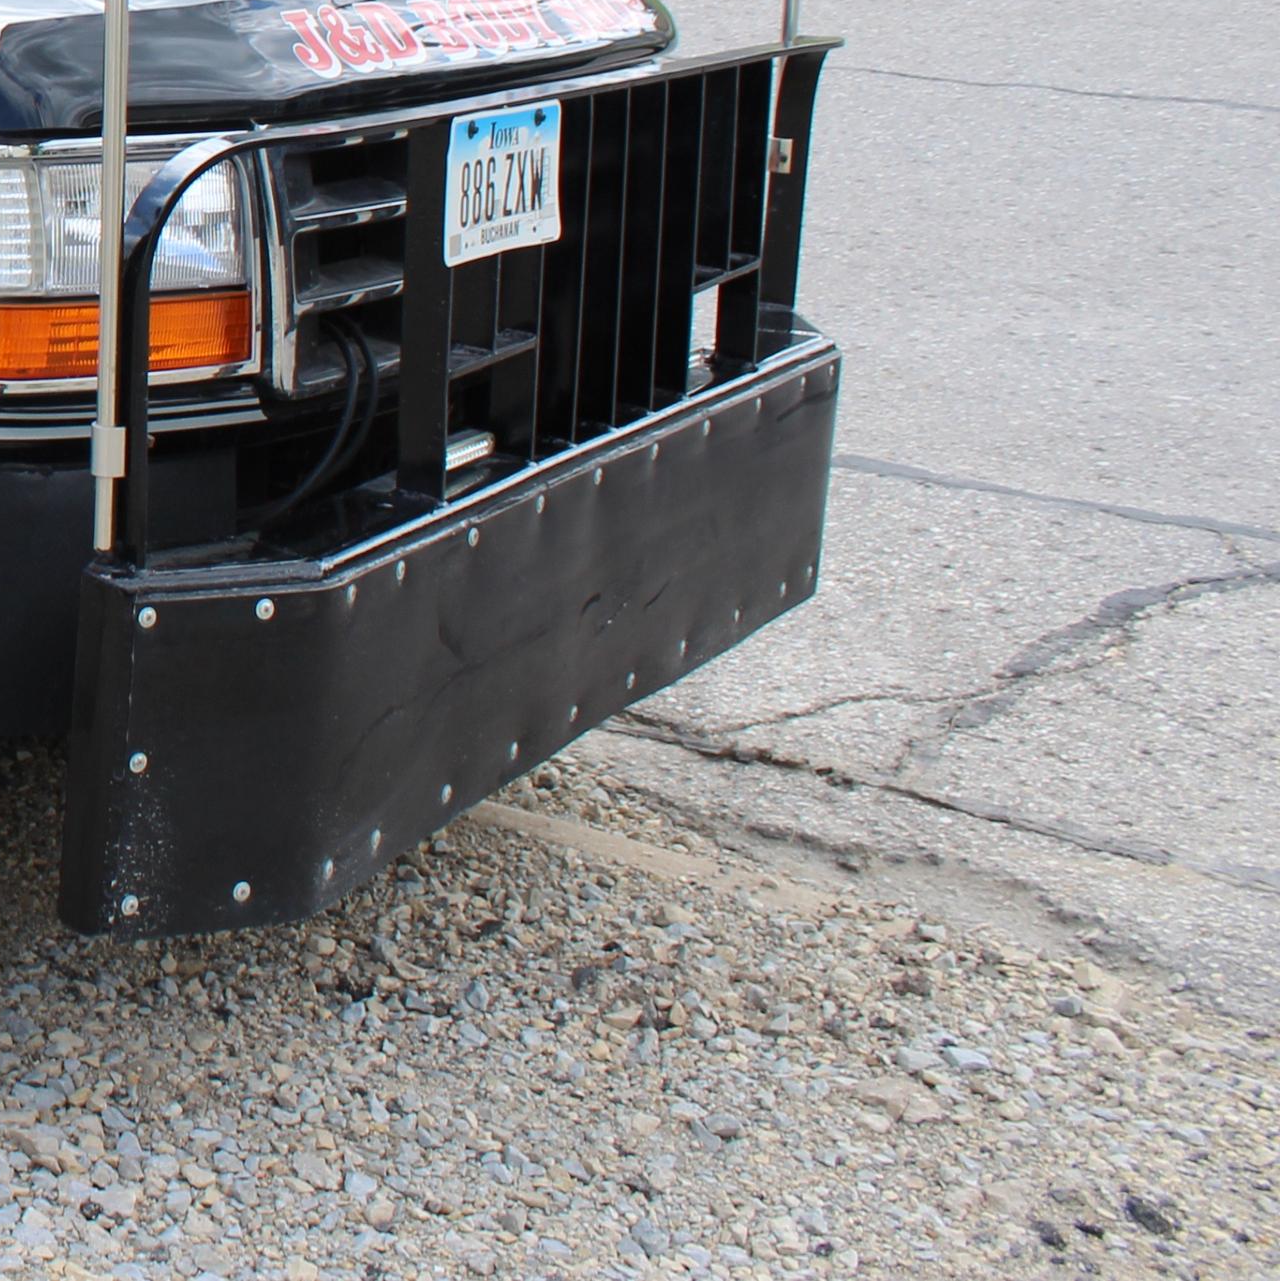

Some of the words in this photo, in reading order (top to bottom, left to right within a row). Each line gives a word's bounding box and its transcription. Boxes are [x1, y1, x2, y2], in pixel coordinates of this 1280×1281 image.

[281, 1, 426, 78] J&D
[460, 156, 496, 228] 886
[503, 147, 545, 217] ZXW
[480, 222, 520, 245] BUCHANAN
